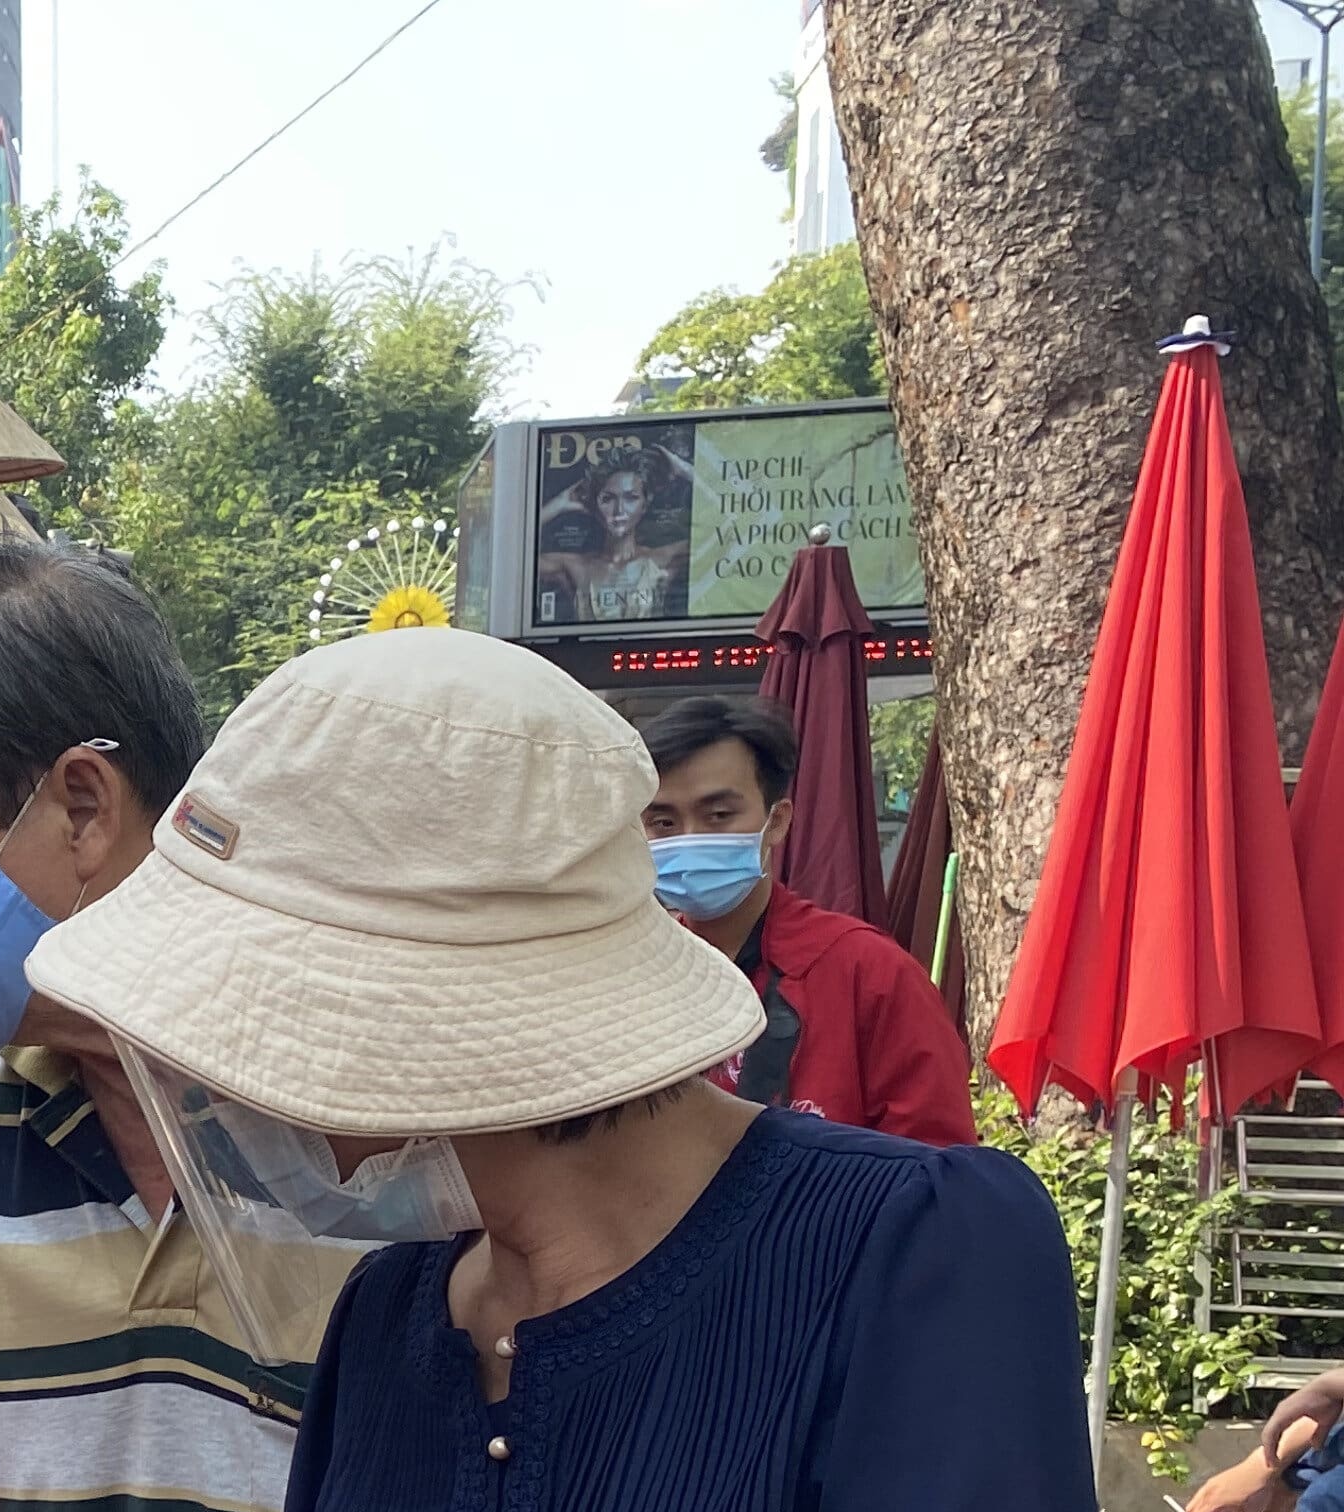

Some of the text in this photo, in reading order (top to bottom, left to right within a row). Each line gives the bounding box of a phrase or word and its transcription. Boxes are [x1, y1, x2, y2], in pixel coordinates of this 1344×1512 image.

[721, 458, 759, 485] TẠP
[719, 483, 771, 514] THỜI
[779, 485, 861, 511] TRANG,
[715, 520, 742, 547] VÀ
[748, 521, 831, 545] PHON
[838, 513, 901, 541] CÁCH
[715, 556, 763, 579] CAO
